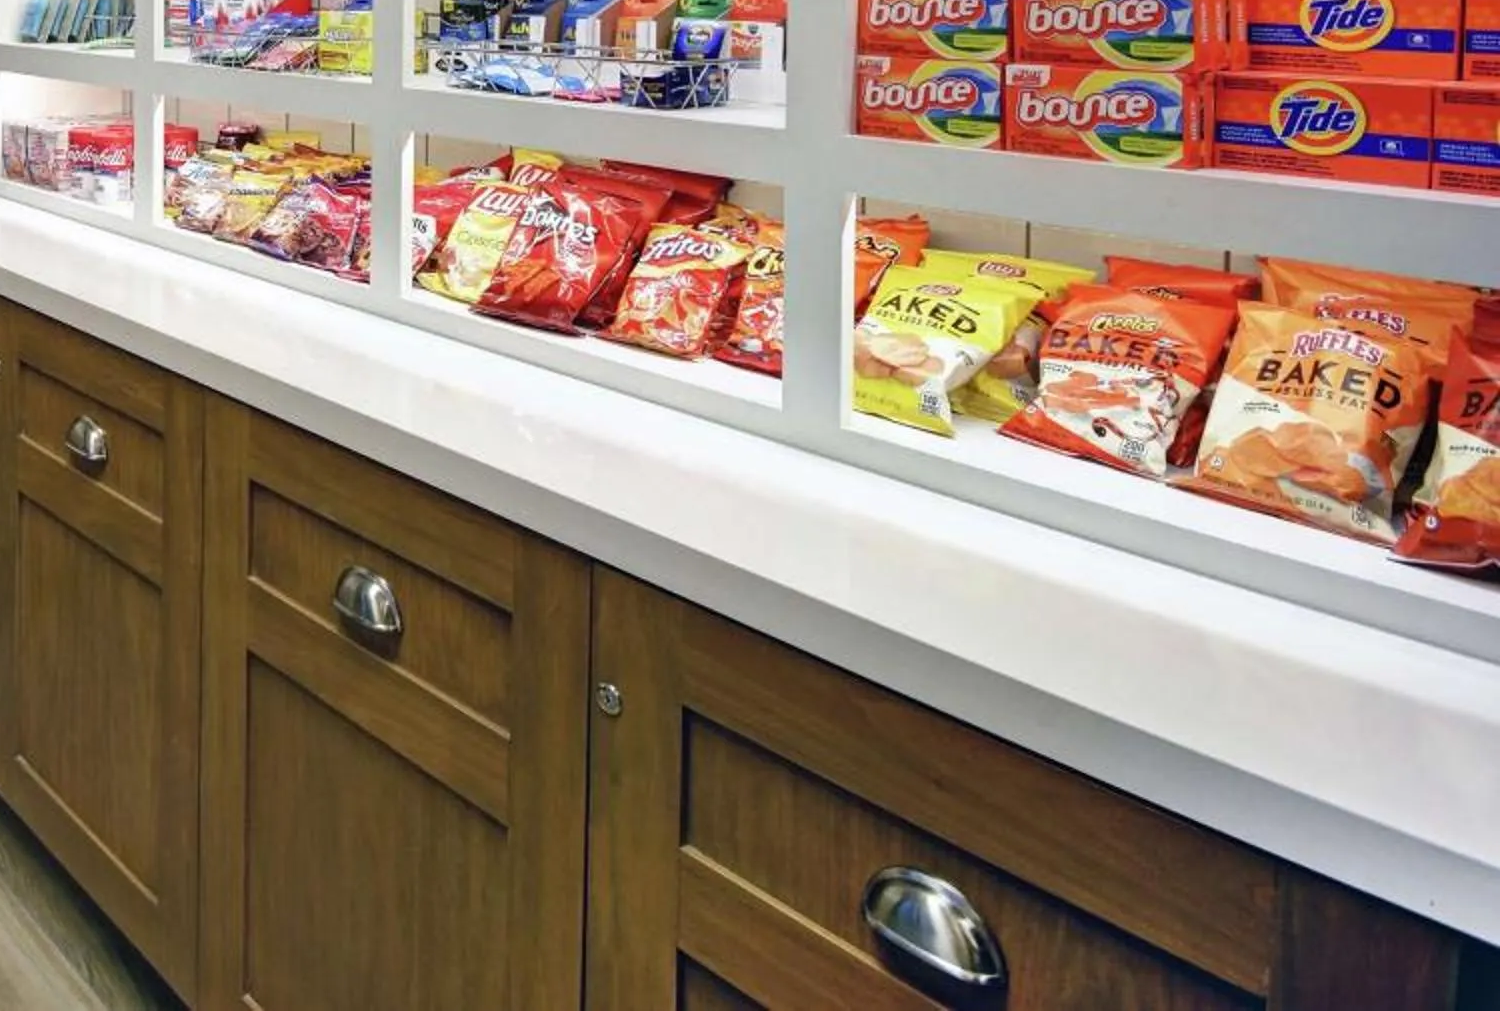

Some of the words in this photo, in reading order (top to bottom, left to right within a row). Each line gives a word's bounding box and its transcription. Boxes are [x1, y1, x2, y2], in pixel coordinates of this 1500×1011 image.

[864, 78, 972, 110] bounce
[1018, 93, 1150, 126] bounce
[1279, 100, 1357, 139] Tide
[640, 232, 723, 262] Fritos
[881, 294, 978, 335] AKED
[1291, 329, 1383, 365] RUFFLES
[1256, 359, 1401, 410] BAKED
